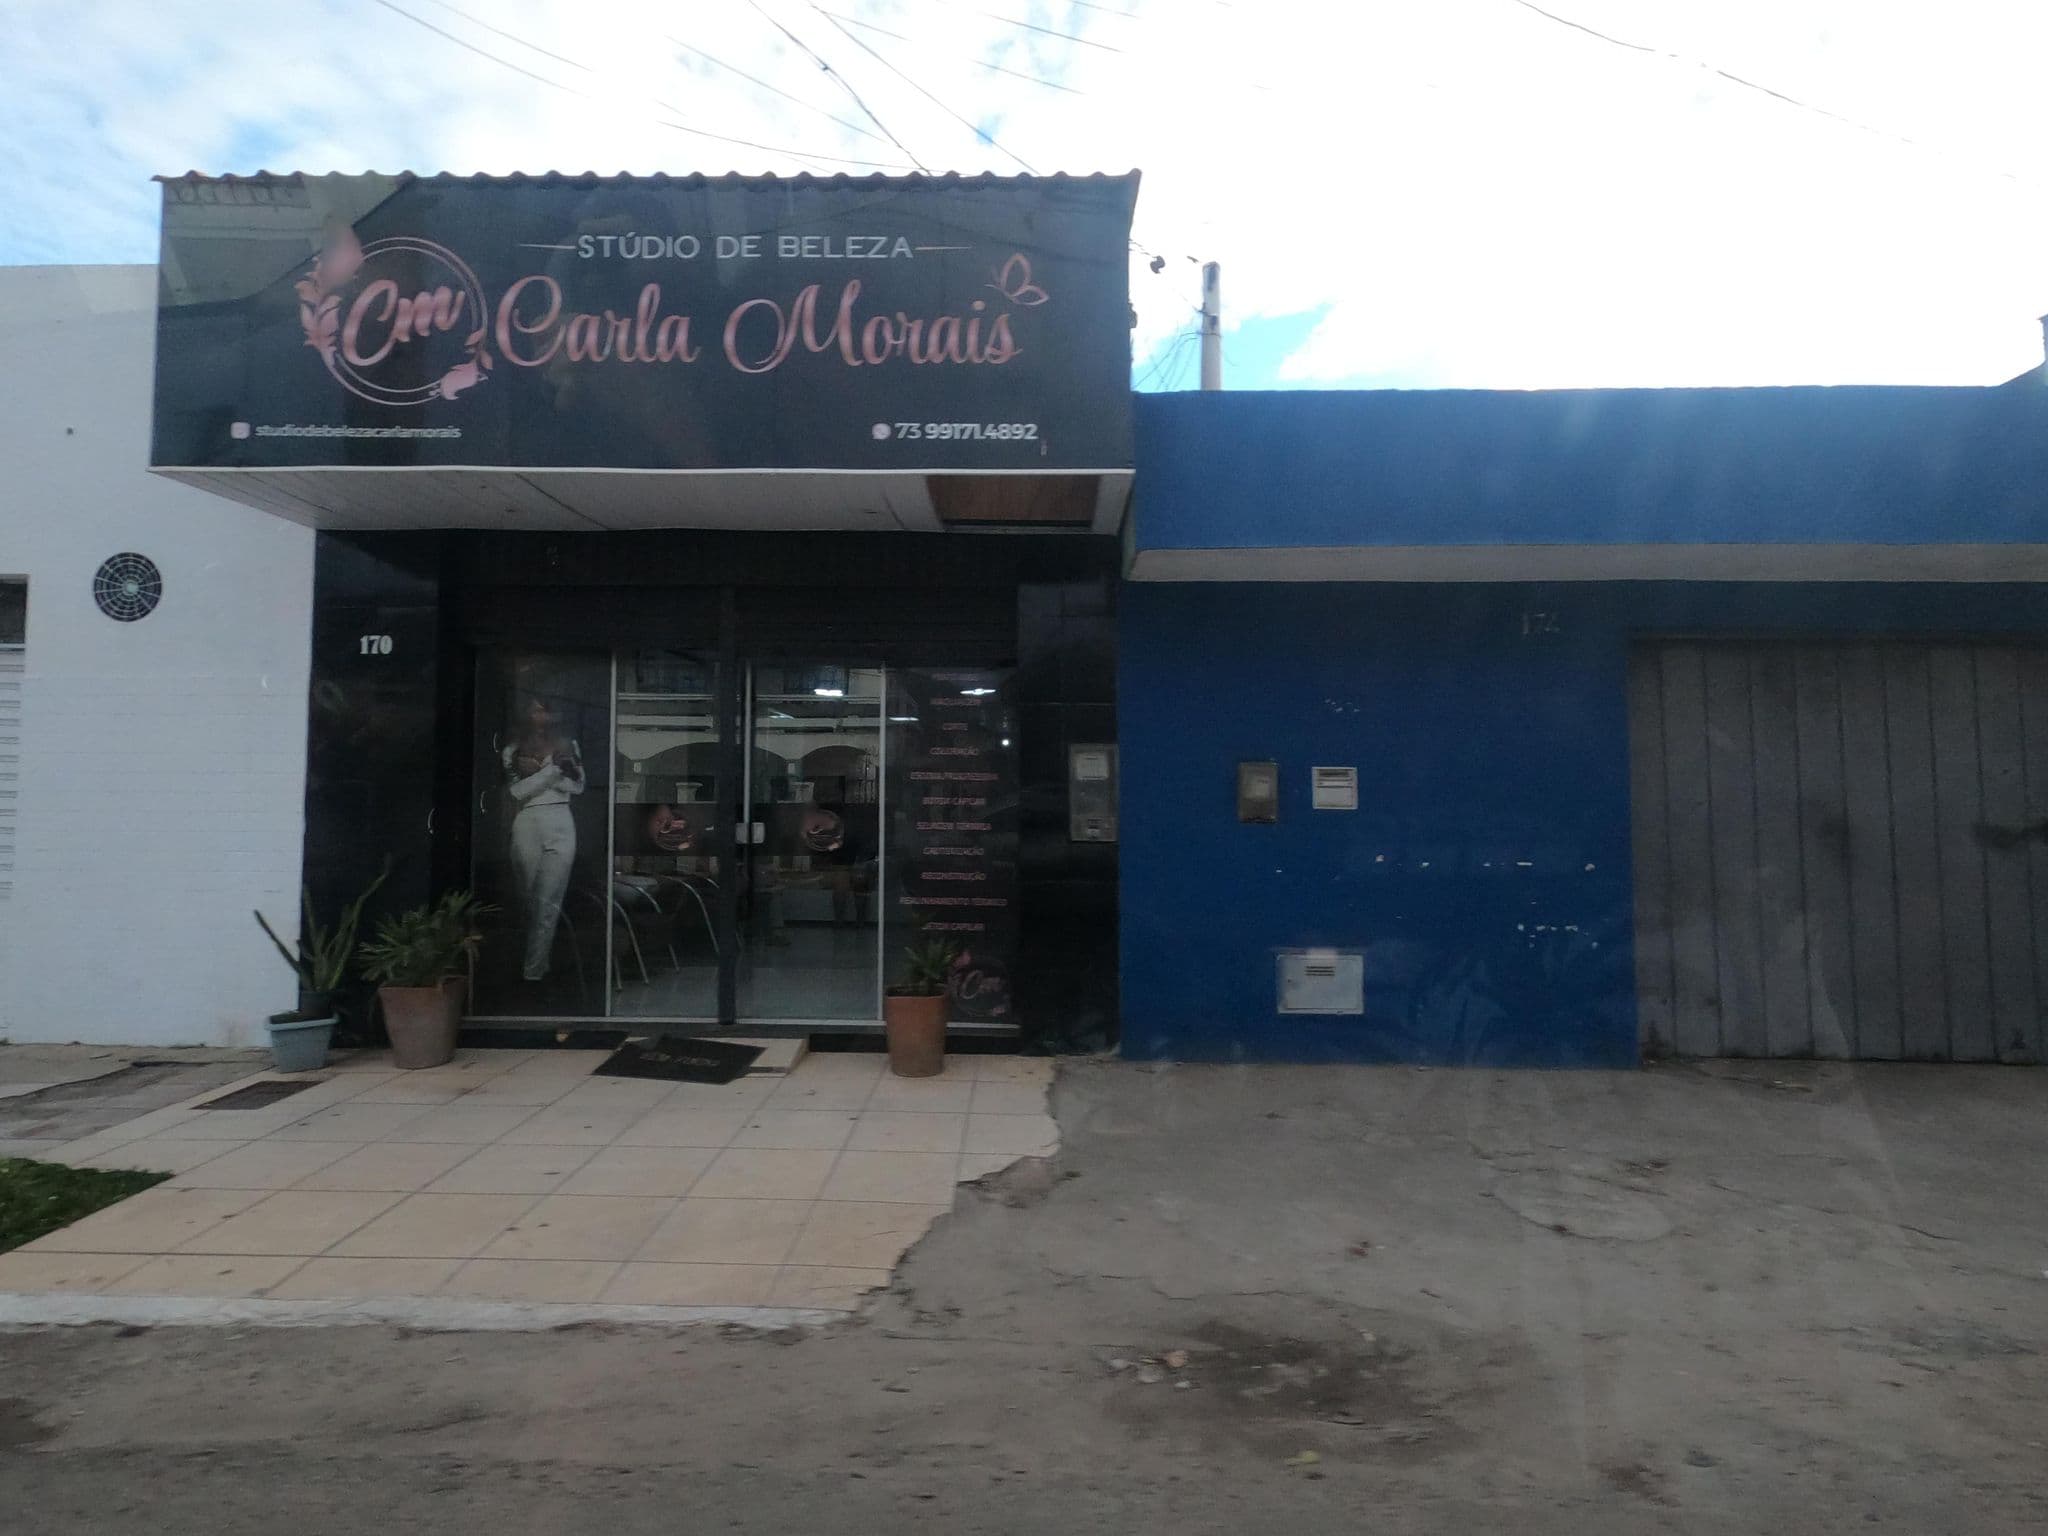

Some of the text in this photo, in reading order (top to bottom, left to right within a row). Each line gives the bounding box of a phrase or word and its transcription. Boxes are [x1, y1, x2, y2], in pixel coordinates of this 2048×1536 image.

[577, 231, 914, 259] STÚDIO DE BELEZA
[495, 274, 1024, 374] Carla Morais
[894, 422, 922, 440] 73
[359, 633, 394, 656] 170
